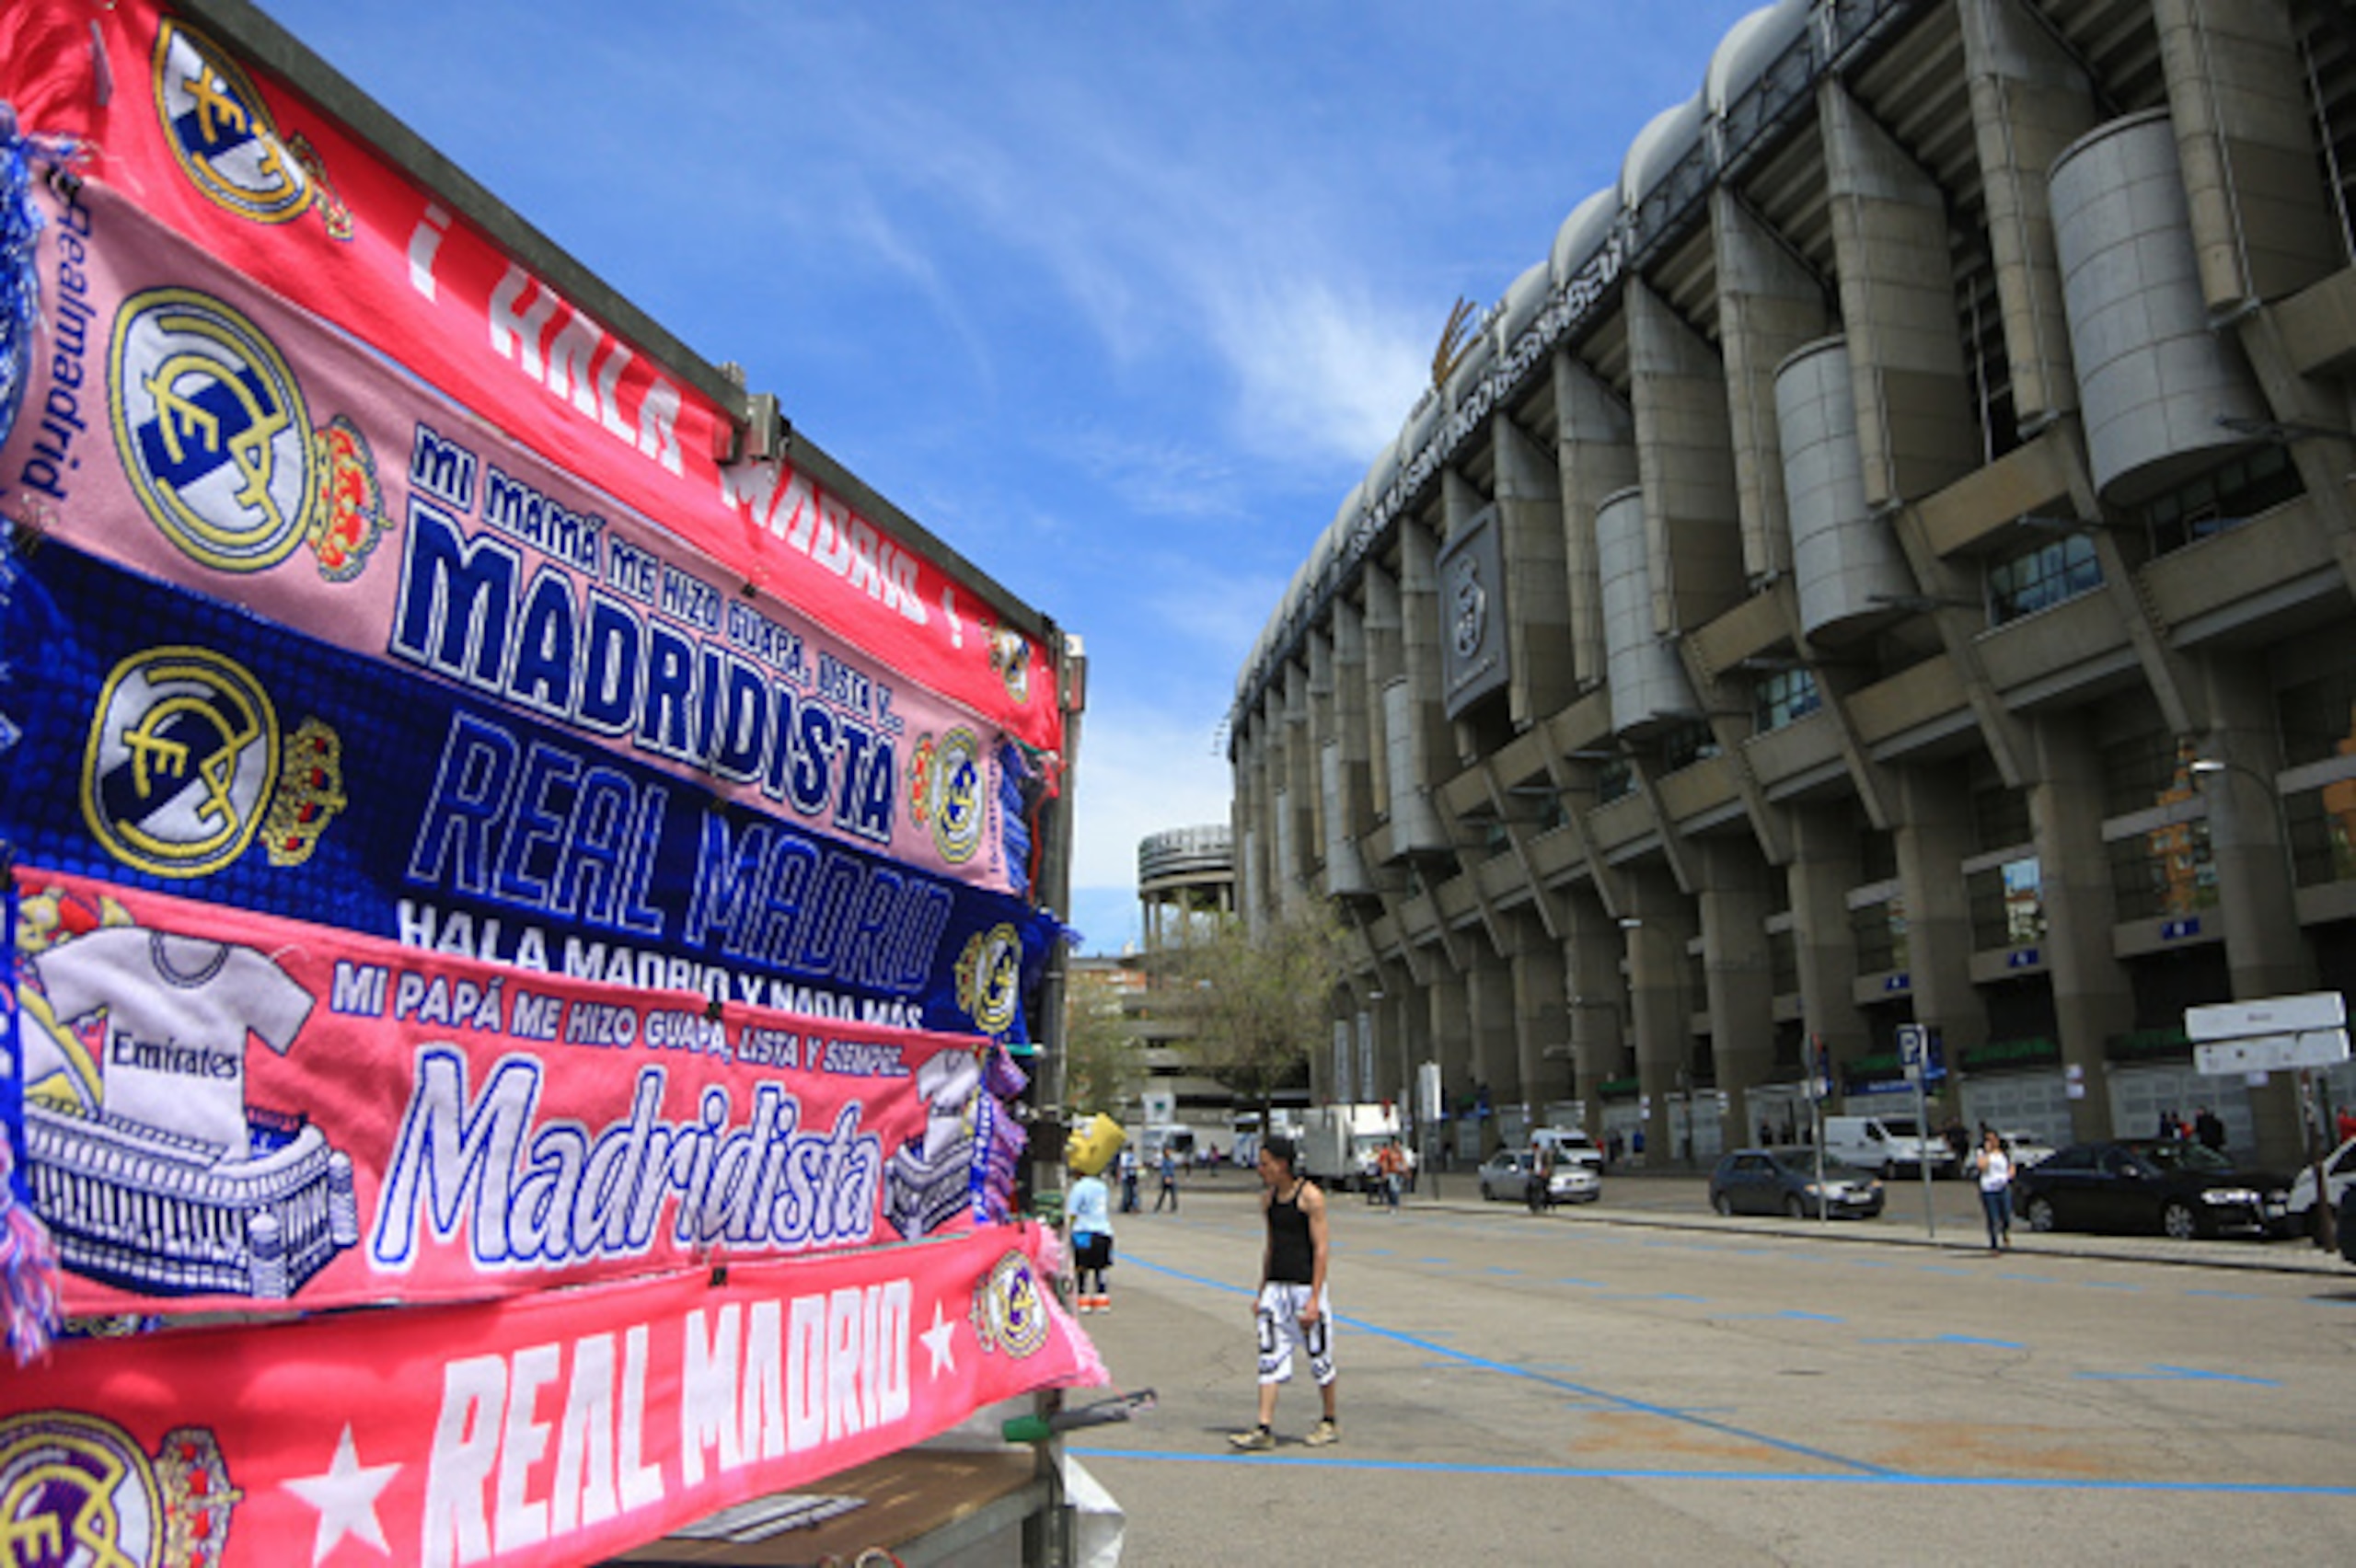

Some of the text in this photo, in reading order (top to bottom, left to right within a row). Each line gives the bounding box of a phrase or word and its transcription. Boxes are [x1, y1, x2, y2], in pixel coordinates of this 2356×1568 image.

[409, 421, 479, 513] MI
[480, 462, 606, 581] MAMÁ
[605, 531, 659, 606] ME
[660, 560, 722, 635] HIZO
[489, 261, 684, 479] HALA
[720, 455, 927, 626] MADRID
[941, 585, 963, 649] !
[389, 491, 897, 846] MADRIDISTA
[396, 896, 550, 974] HALA
[563, 935, 730, 1010] MADRID
[738, 971, 764, 1007] Y
[769, 978, 856, 1021] NADA
[404, 710, 670, 940] REAL
[683, 803, 955, 997] MADRID
[111, 1028, 237, 1080] Emirates
[330, 960, 388, 1018] MI
[393, 974, 505, 1033] PAPÁ
[510, 989, 564, 1041] ME
[564, 1000, 638, 1050] HIZO
[737, 1022, 799, 1070] LISTA
[804, 1034, 823, 1071] Y
[1900, 1031, 1920, 1063] P
[367, 1043, 884, 1274] Madridista
[421, 1277, 914, 1568] REAL MADRID
